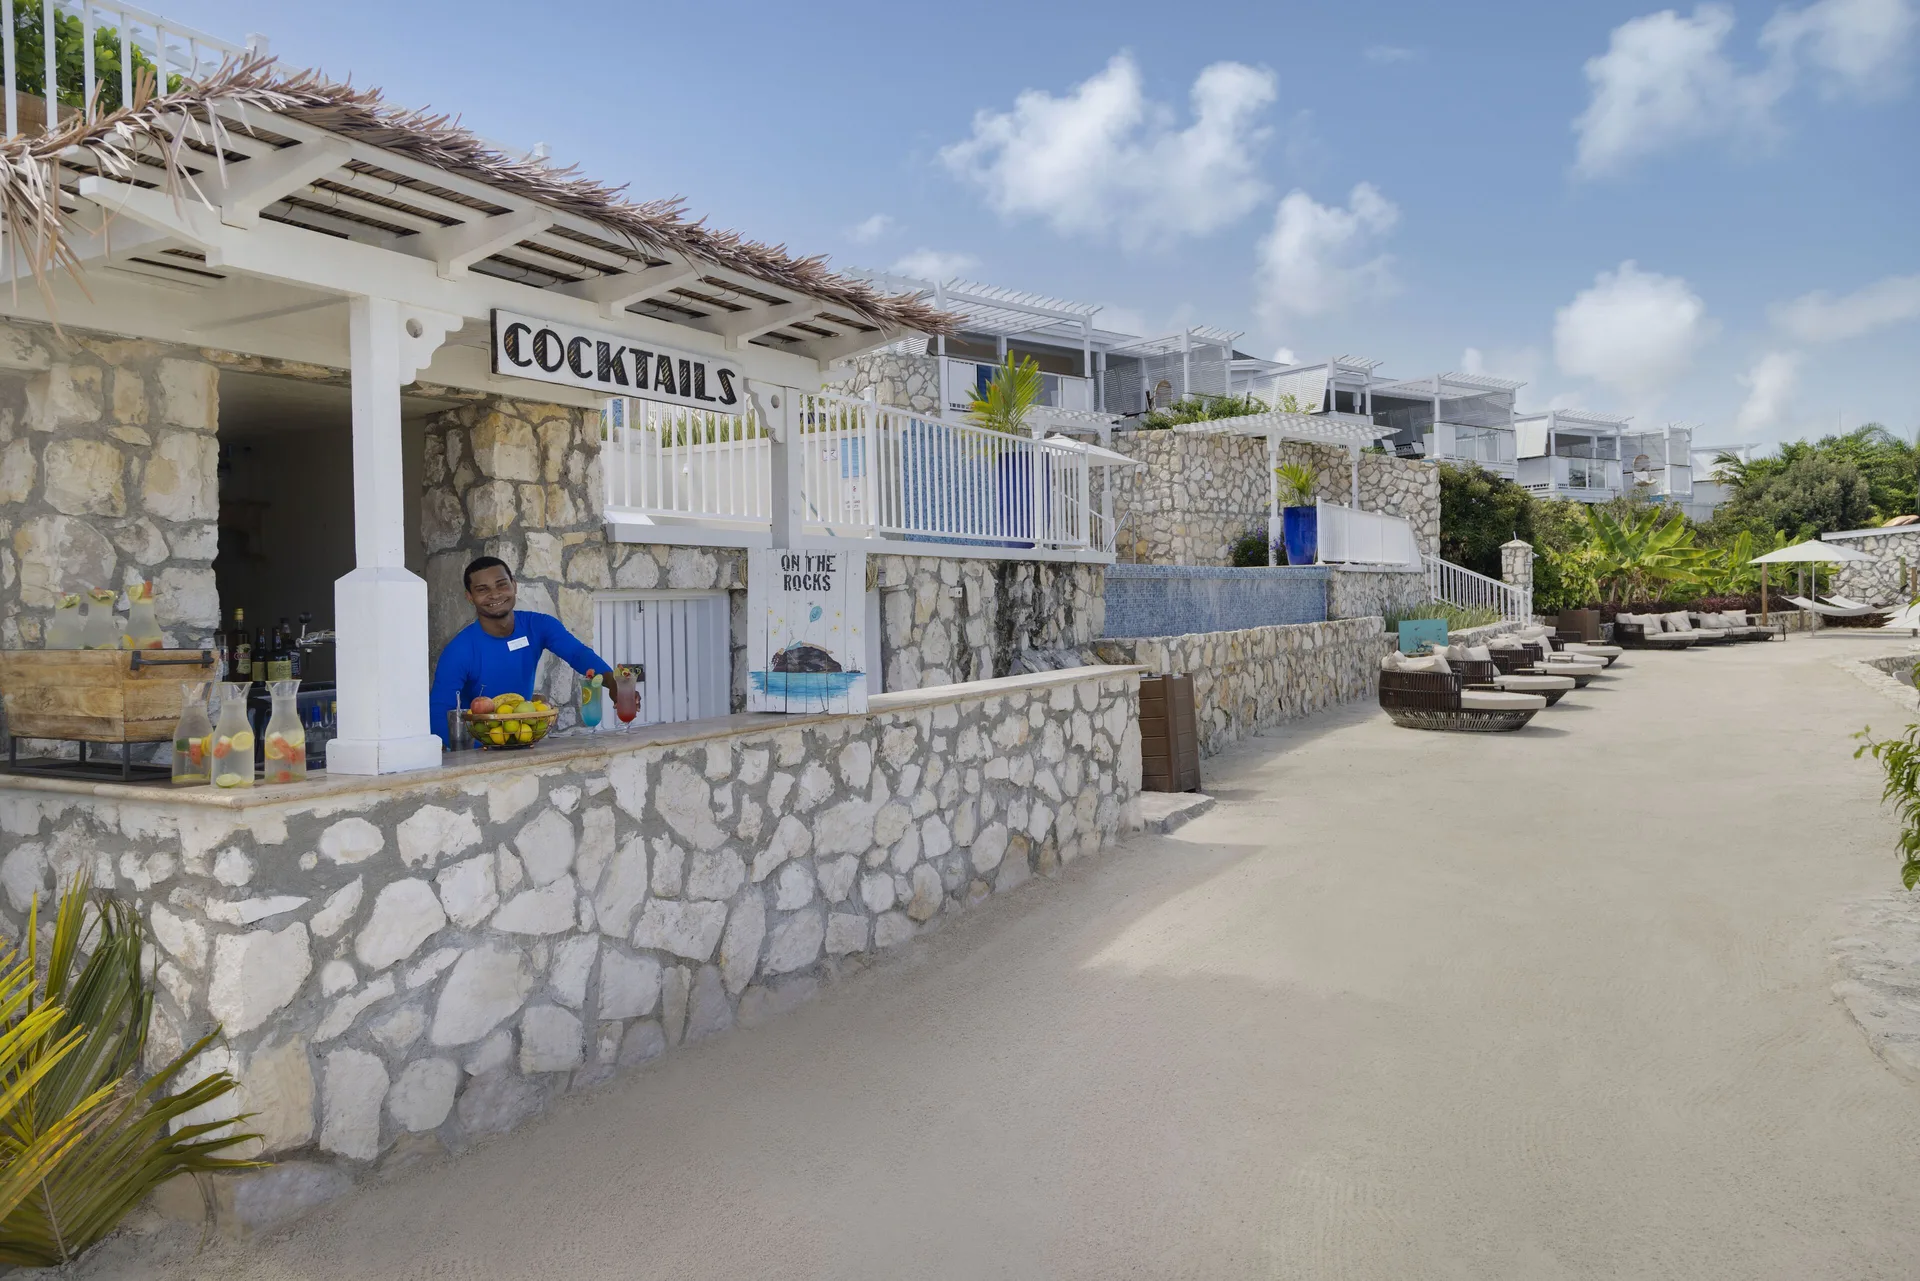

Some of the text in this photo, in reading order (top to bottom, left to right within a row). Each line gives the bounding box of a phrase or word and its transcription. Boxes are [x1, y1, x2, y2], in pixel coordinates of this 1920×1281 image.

[504, 322, 738, 405] COCKTAILS
[781, 555, 836, 572] ON THE
[784, 574, 831, 591] ROCKS
